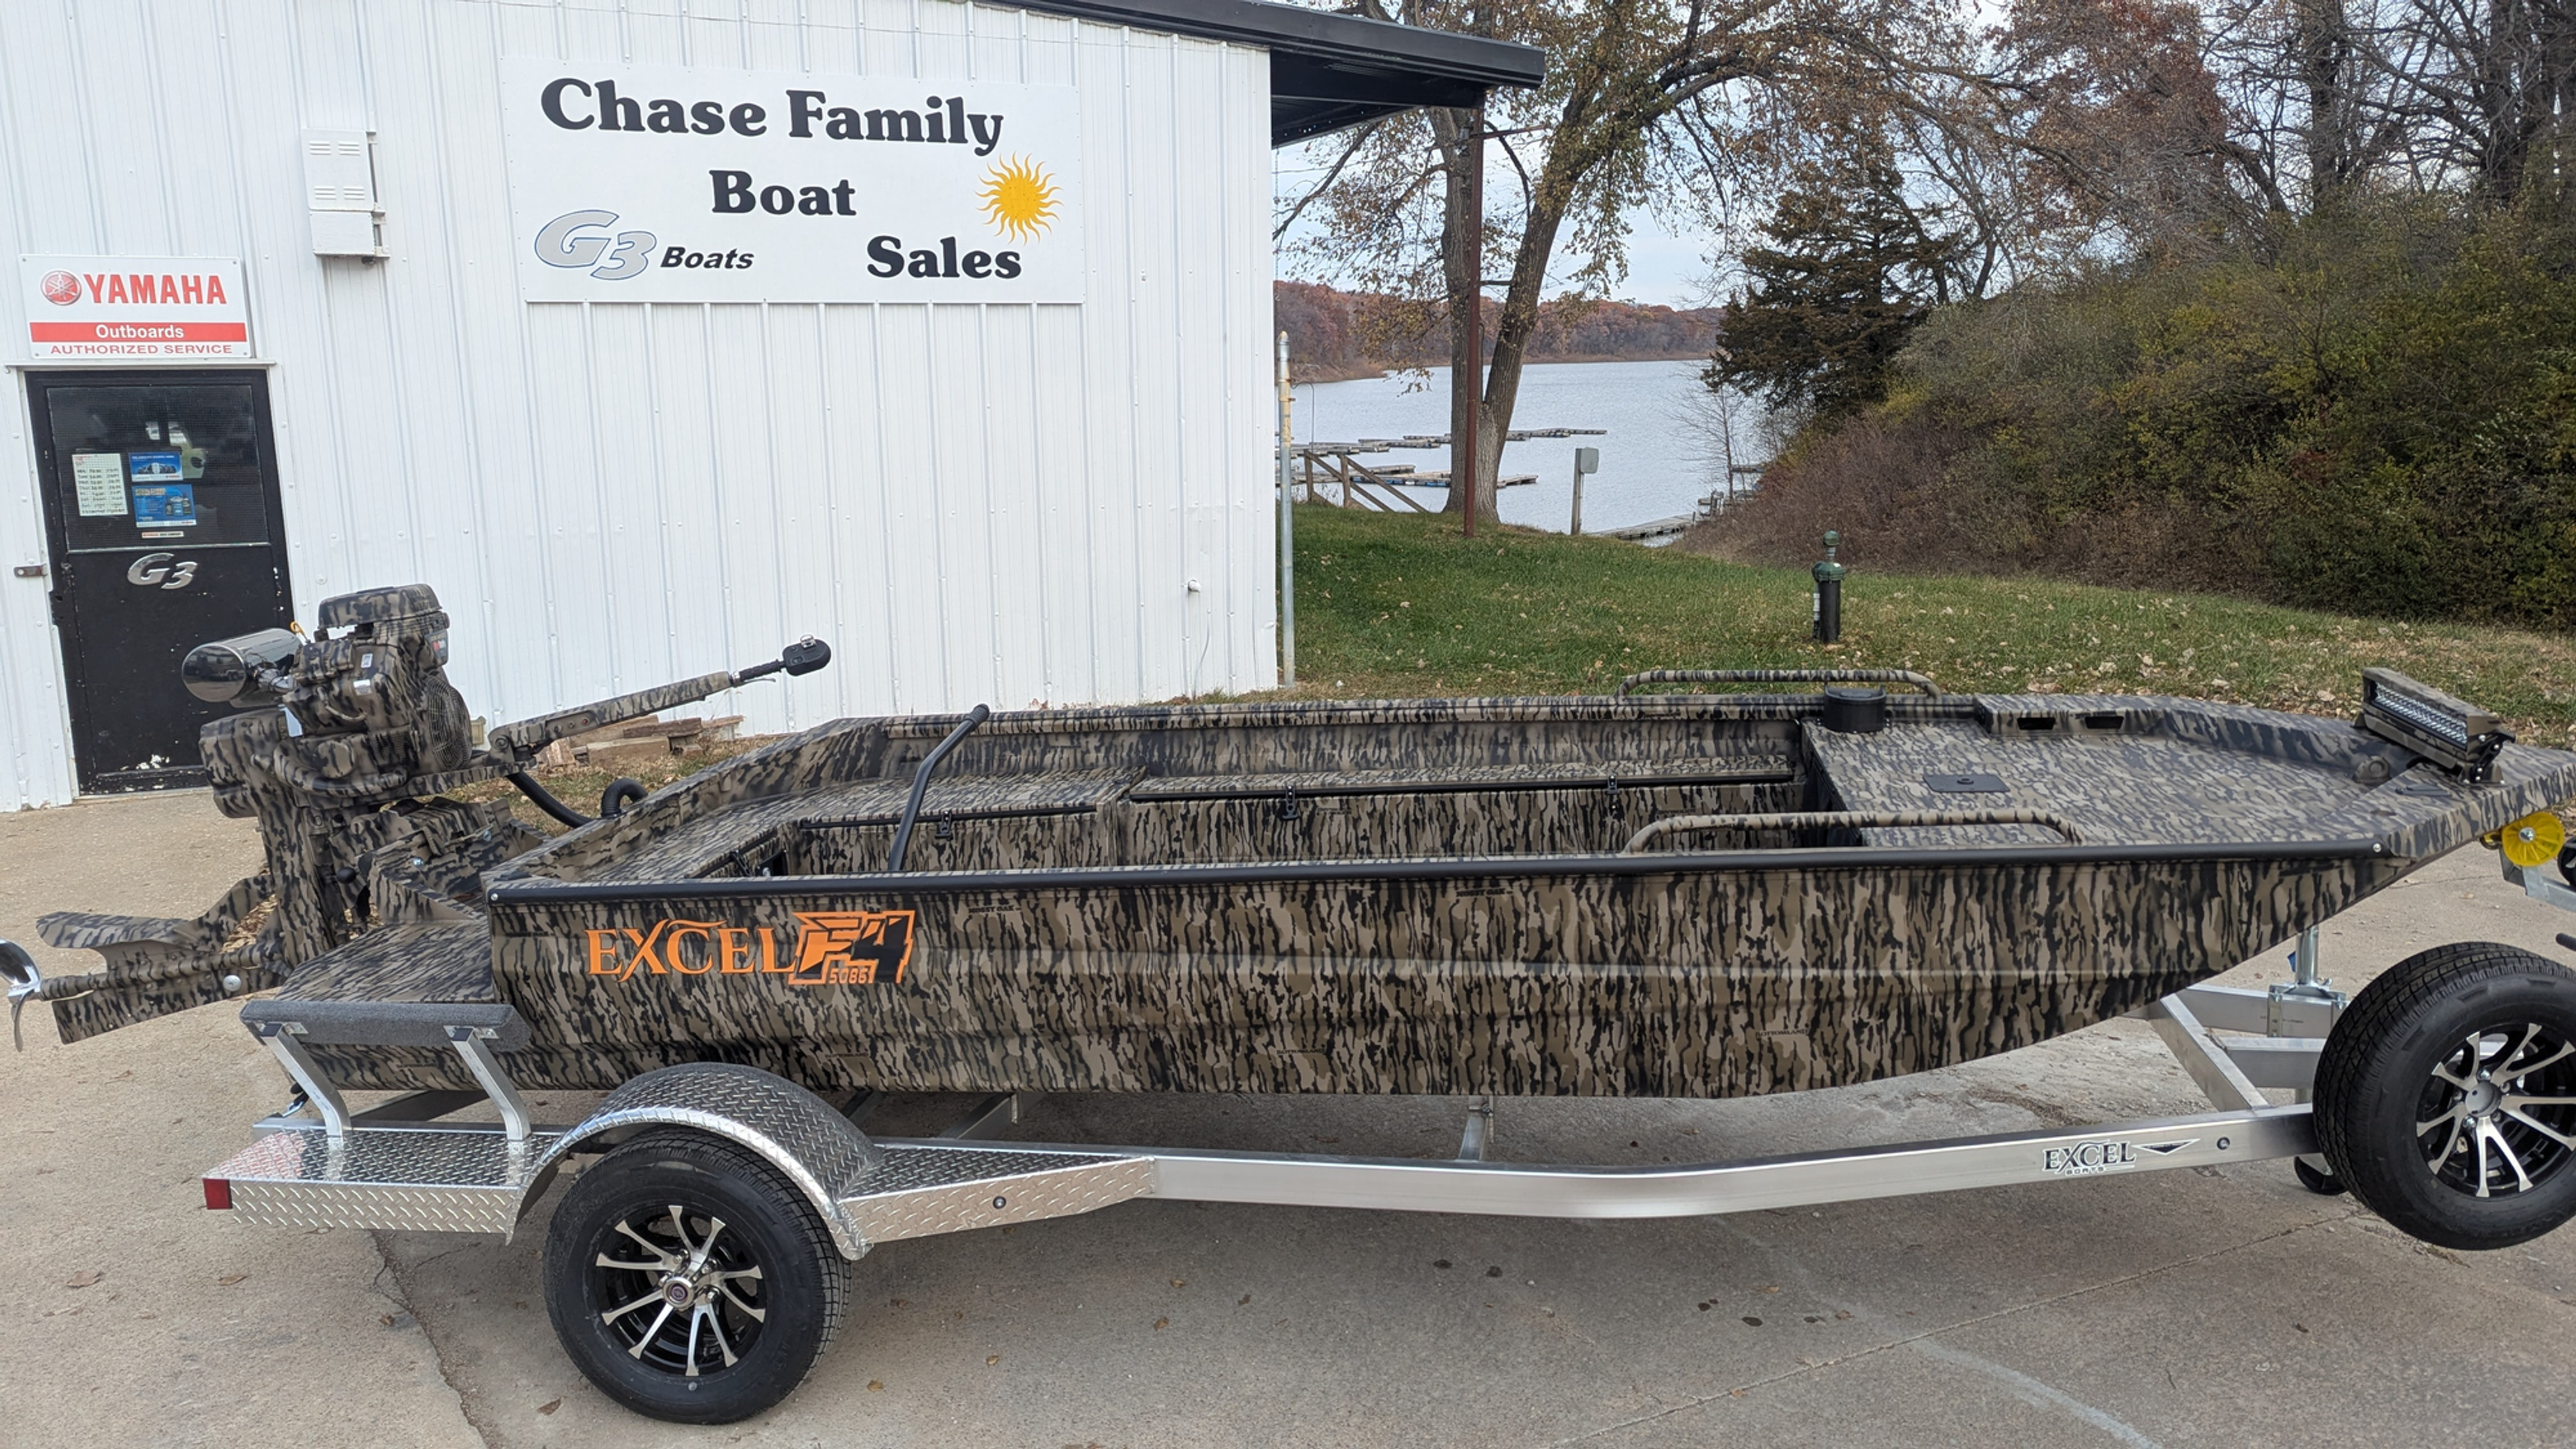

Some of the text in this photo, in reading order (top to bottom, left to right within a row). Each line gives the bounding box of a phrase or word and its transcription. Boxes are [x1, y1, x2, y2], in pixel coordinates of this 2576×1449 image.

[542, 78, 1004, 156] Chase Family
[709, 169, 857, 216] Boat
[534, 210, 755, 280] G3 Boats
[867, 235, 1022, 279] Sales
[83, 273, 227, 305] YAMAHA
[50, 344, 233, 355] AUTHORIZED SERVICE
[95, 325, 185, 339] Outboards
[127, 552, 198, 590] G3
[584, 910, 916, 985] EXCEL F4
[829, 967, 868, 984] 5086
[2044, 1139, 2136, 1173] EXCEL
